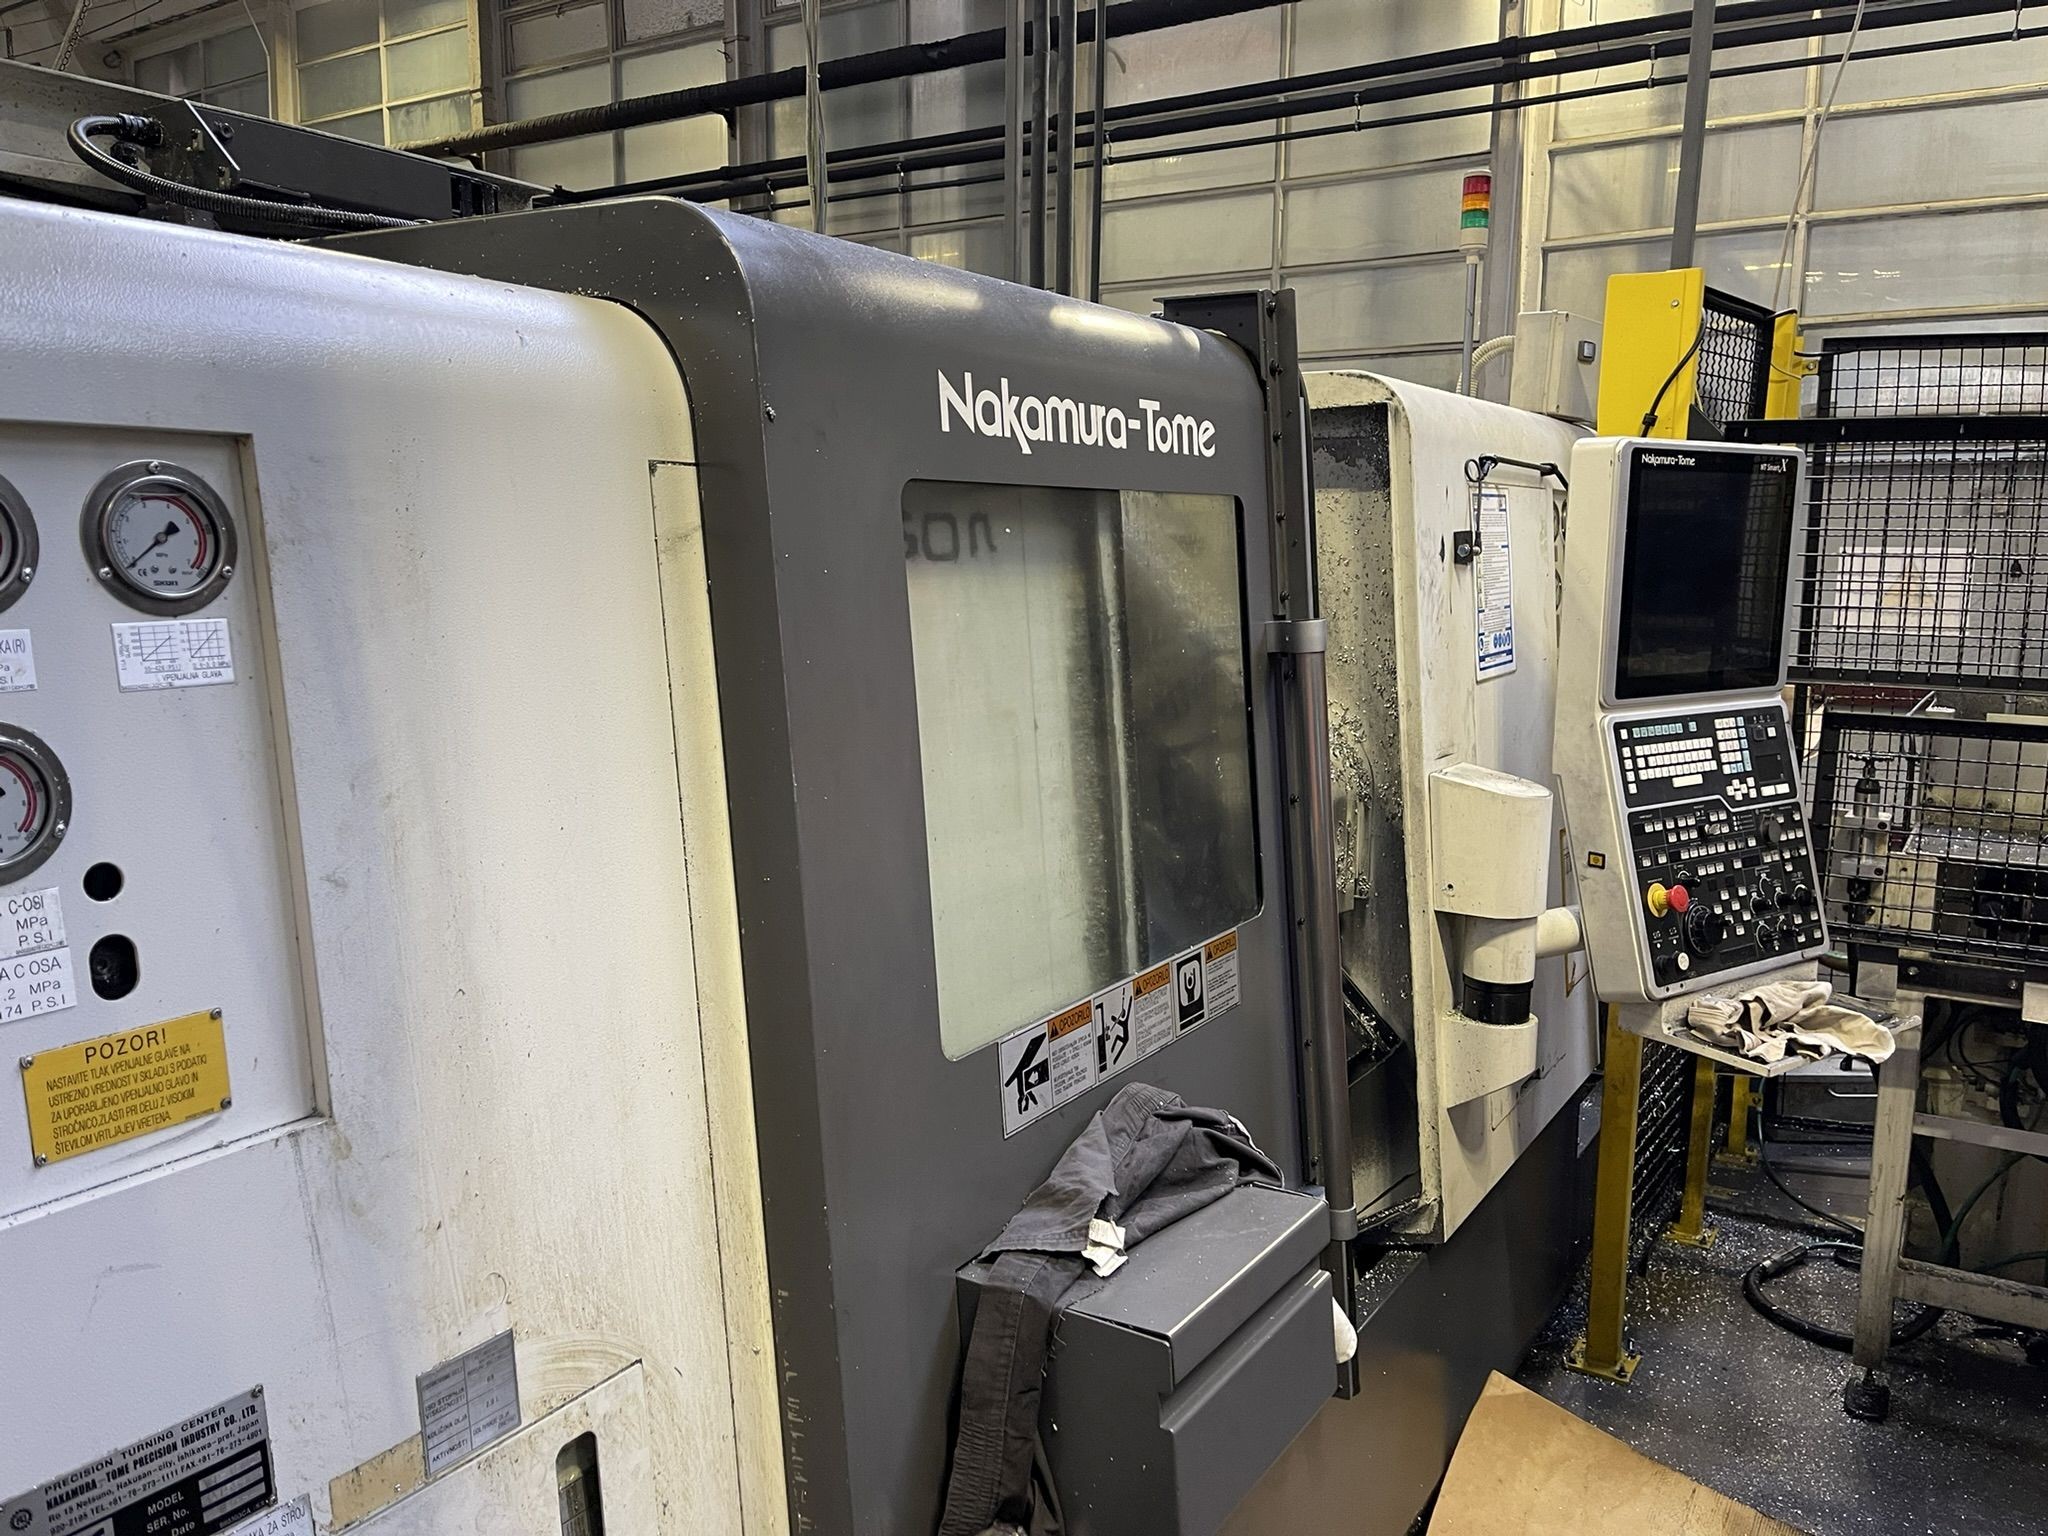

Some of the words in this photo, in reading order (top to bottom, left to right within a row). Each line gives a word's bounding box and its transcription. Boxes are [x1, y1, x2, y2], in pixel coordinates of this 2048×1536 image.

[938, 369, 1216, 458] Nakamura-Tome
[1641, 454, 1696, 467] Nakamura-Tome
[16, 916, 48, 931] MPa
[29, 956, 62, 975] OSA
[29, 980, 61, 995] MPa
[84, 1028, 167, 1064] POZOR!
[46, 1070, 88, 1092] NASTAVITE
[90, 1064, 110, 1080] TLAK
[111, 1052, 153, 1074] VPENJALNE
[154, 1046, 178, 1063] GLAVE
[180, 1043, 191, 1055] NA
[48, 1086, 90, 1108] USTREZNO
[91, 1073, 132, 1096] VREDNOST
[132, 1073, 139, 1084] V
[140, 1064, 169, 1082] SKLADU
[170, 1062, 176, 1074] S
[176, 1054, 207, 1072] PODATKI
[50, 1111, 62, 1124] ZA
[64, 1094, 119, 1117] UPORABLJENO
[120, 1081, 164, 1103] VPENJALNO
[165, 1073, 191, 1091] GLAVO
[192, 1071, 199, 1082] IN
[125, 1105, 138, 1118] PRI
[140, 1099, 159, 1114] DELU
[160, 1097, 165, 1108] Z
[165, 1087, 195, 1106] VISOKIM
[55, 1134, 93, 1155] ŠTEVILOM
[94, 1121, 135, 1143] VRTLJAJEV
[237, 1418, 260, 1436] Japan
[44, 1458, 114, 1496] PRECISION
[120, 1430, 174, 1460] TURNING
[181, 1406, 226, 1432] CENTER
[133, 1442, 178, 1471] PRECISION
[181, 1421, 221, 1449] INDUSTRY
[146, 1491, 185, 1517] MODEL
[146, 1518, 171, 1535] SER.
[173, 1507, 190, 1522] No.
[171, 1521, 196, 1536] Date
[266, 1520, 279, 1536] ZA
[281, 1505, 306, 1528] STROJ
